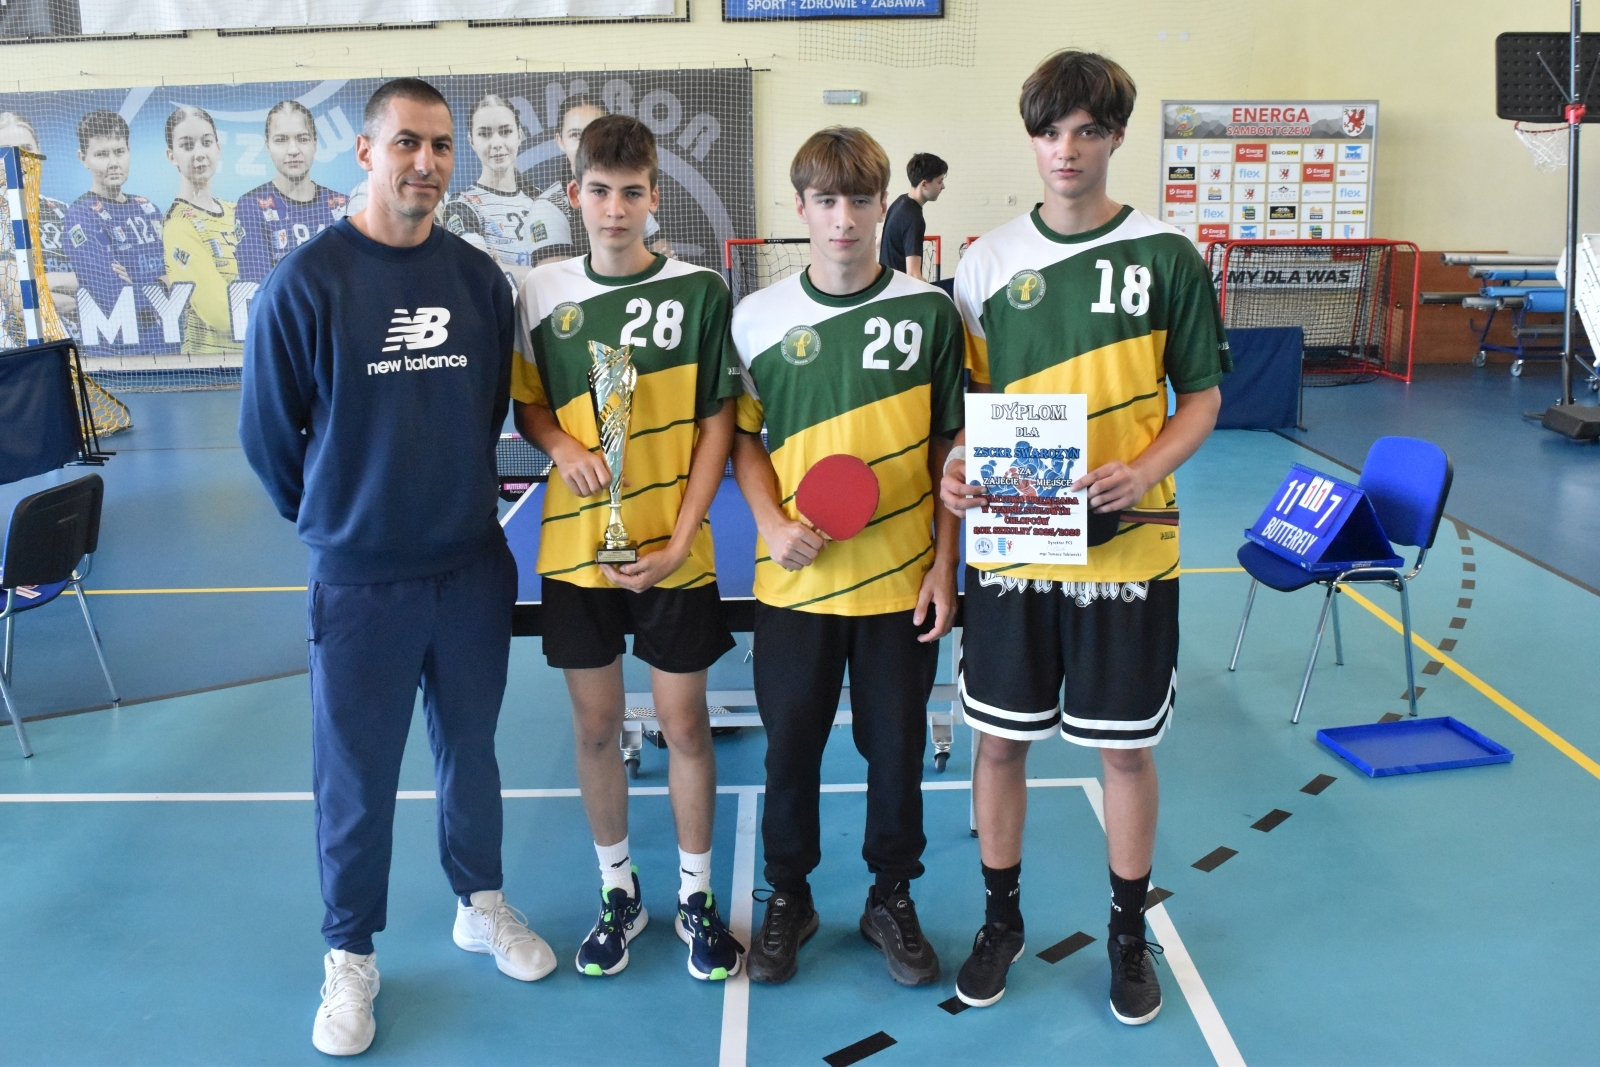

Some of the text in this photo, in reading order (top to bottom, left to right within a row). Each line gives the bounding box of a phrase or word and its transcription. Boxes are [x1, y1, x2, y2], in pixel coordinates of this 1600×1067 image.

[747, 0, 787, 10] SPORT
[800, 0, 857, 9] ZDROWIE
[1232, 107, 1310, 122] ENERGA
[1227, 126, 1312, 136] SAMBOR TCZEW
[1239, 167, 1260, 178] flex
[1340, 187, 1361, 198] flex
[1203, 208, 1224, 218] flex
[1263, 269, 1301, 283] DLA
[1306, 269, 1351, 283] WAS
[1091, 259, 1151, 317] 18
[77, 281, 197, 345] MY
[619, 297, 685, 350] 28
[862, 316, 923, 371] 29
[367, 353, 468, 376] new balance
[991, 401, 1067, 420] DYPLOM
[1015, 427, 1040, 437] DLA
[973, 446, 1012, 458] ZSCKR
[1019, 467, 1033, 475] ZA
[1036, 478, 1073, 488] MIEJSCE
[1276, 479, 1342, 529] 11 11 7
[973, 526, 992, 535] ROK
[992, 525, 1033, 535] SZKOLNY
[1261, 516, 1319, 556] BUTTERFLY
